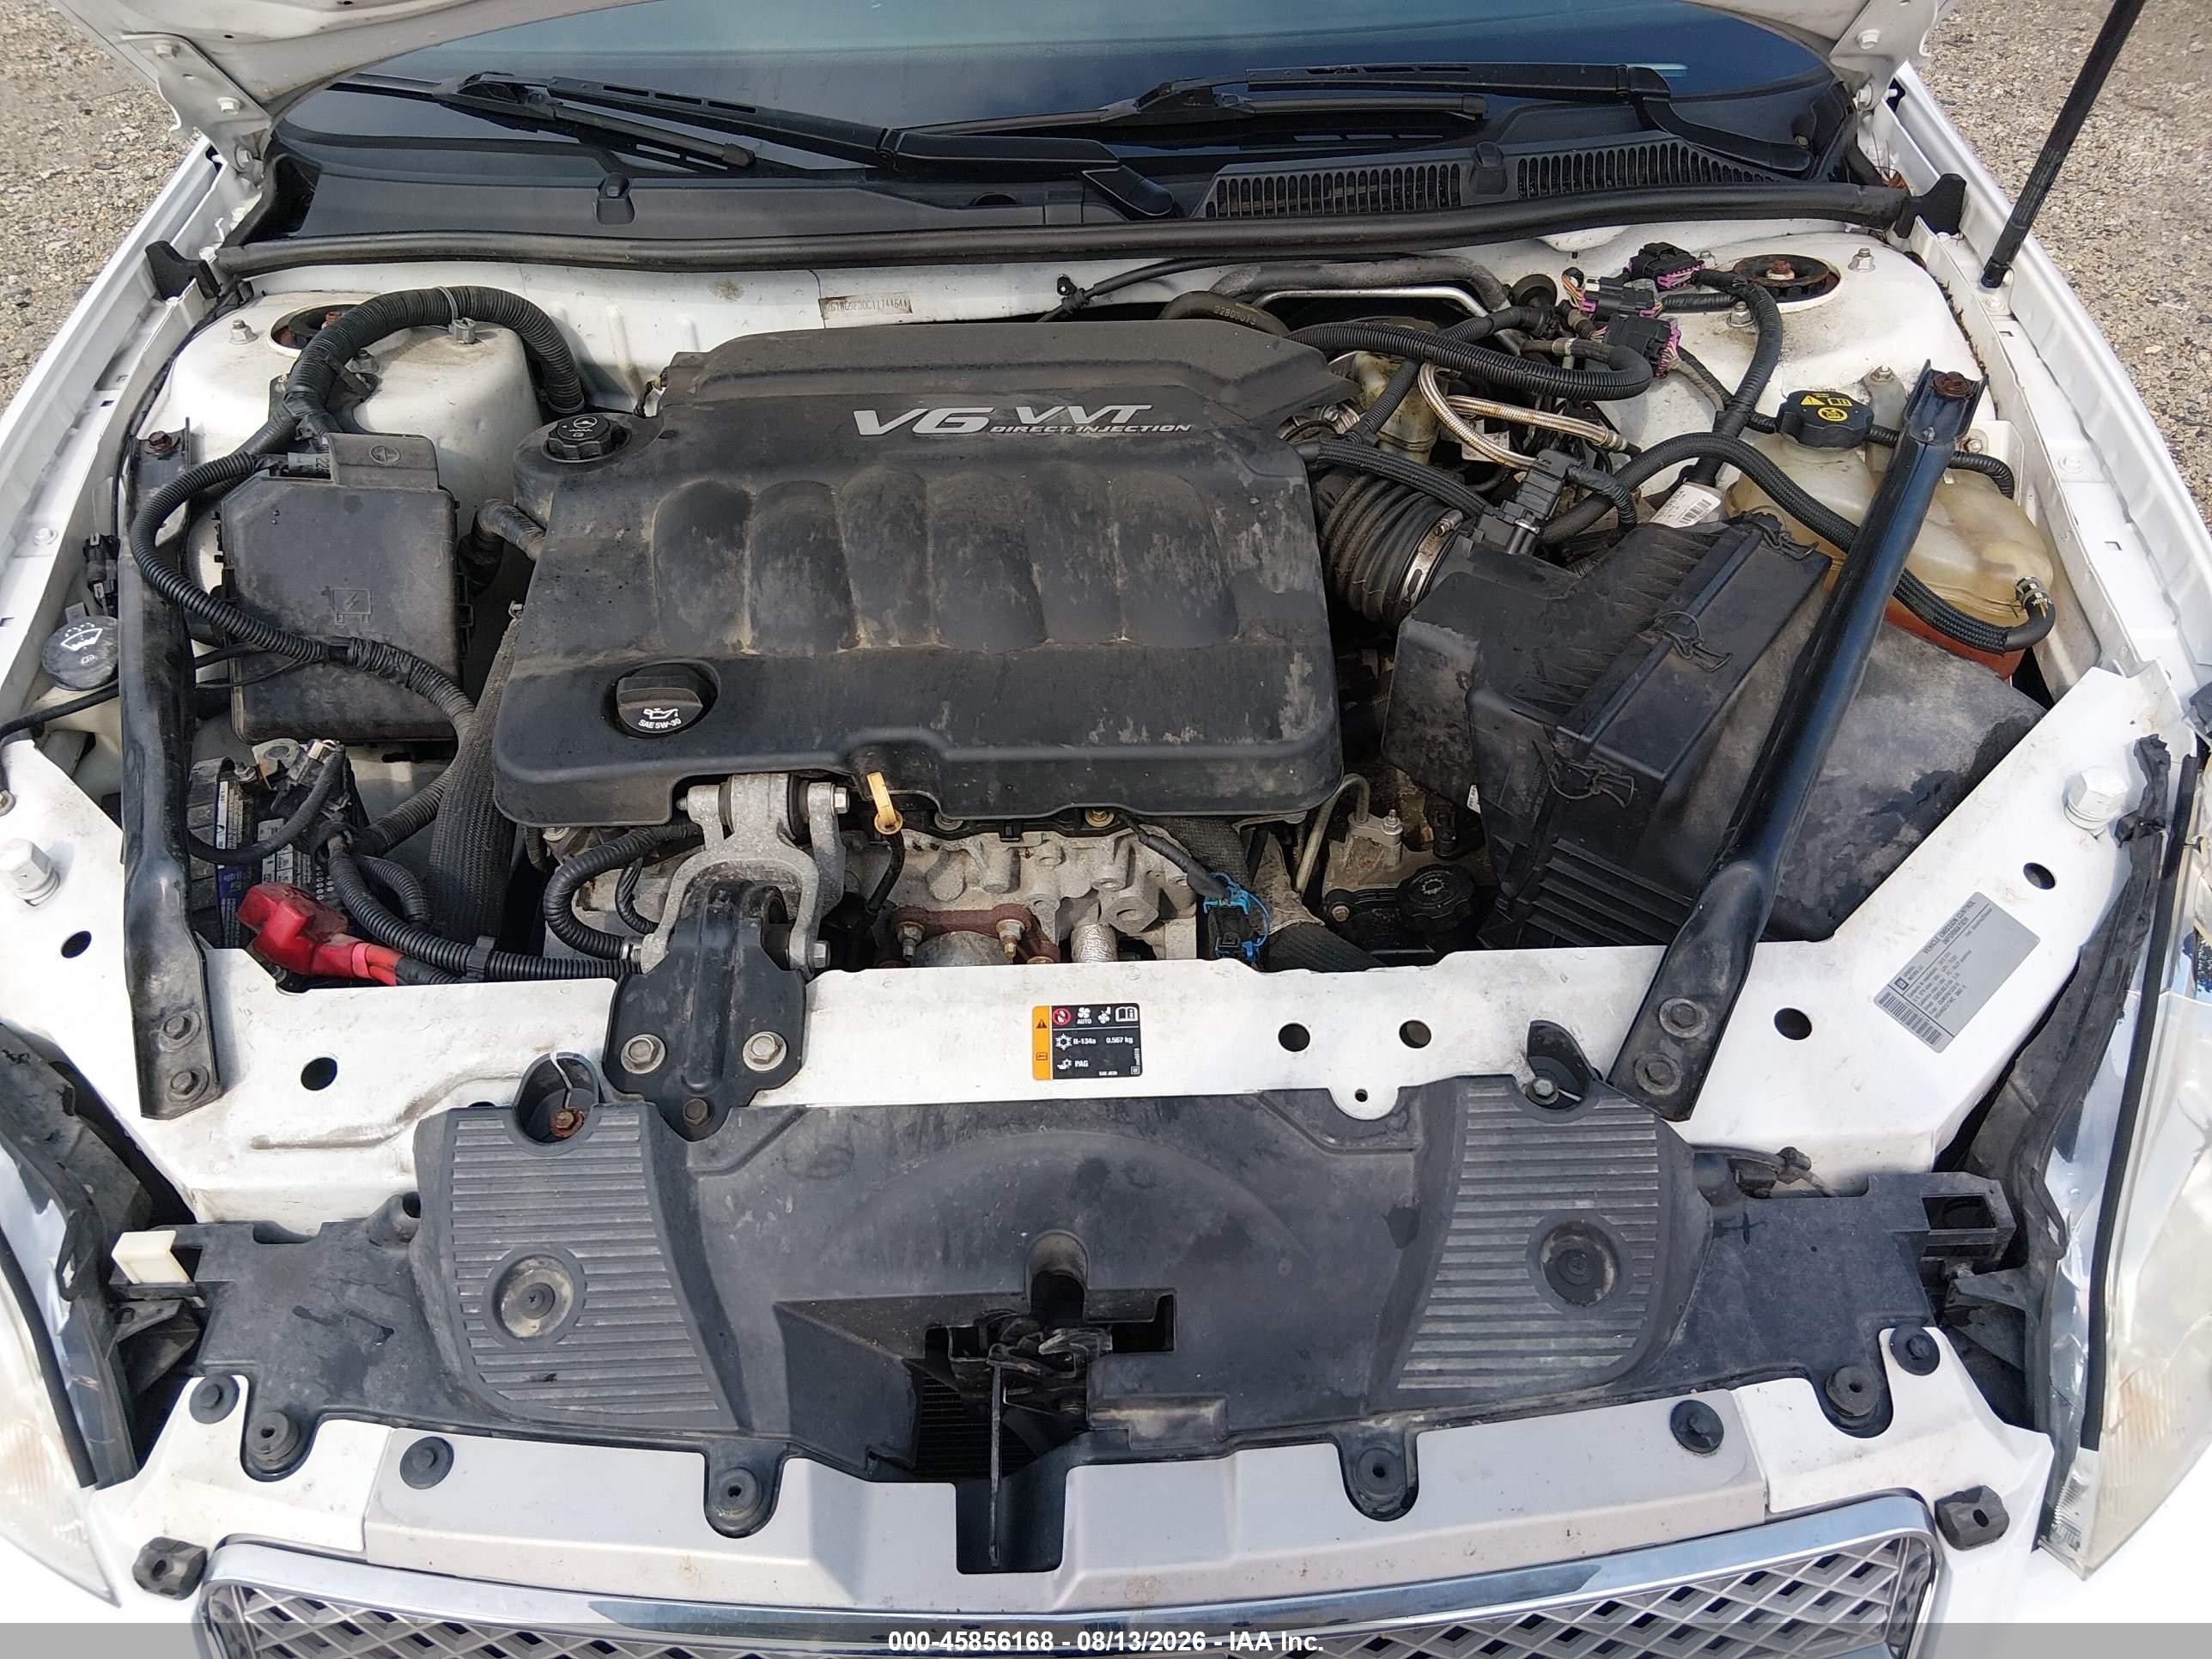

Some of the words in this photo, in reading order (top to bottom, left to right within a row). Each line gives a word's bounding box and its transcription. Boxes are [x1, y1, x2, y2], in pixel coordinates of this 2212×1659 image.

[853, 407, 995, 435] V6
[1016, 405, 1152, 424] VVT
[1076, 424, 1193, 434] INJECTION
[638, 719, 653, 729] SAE
[654, 718, 682, 729] 5W-30
[1125, 1036, 1133, 1044] kg
